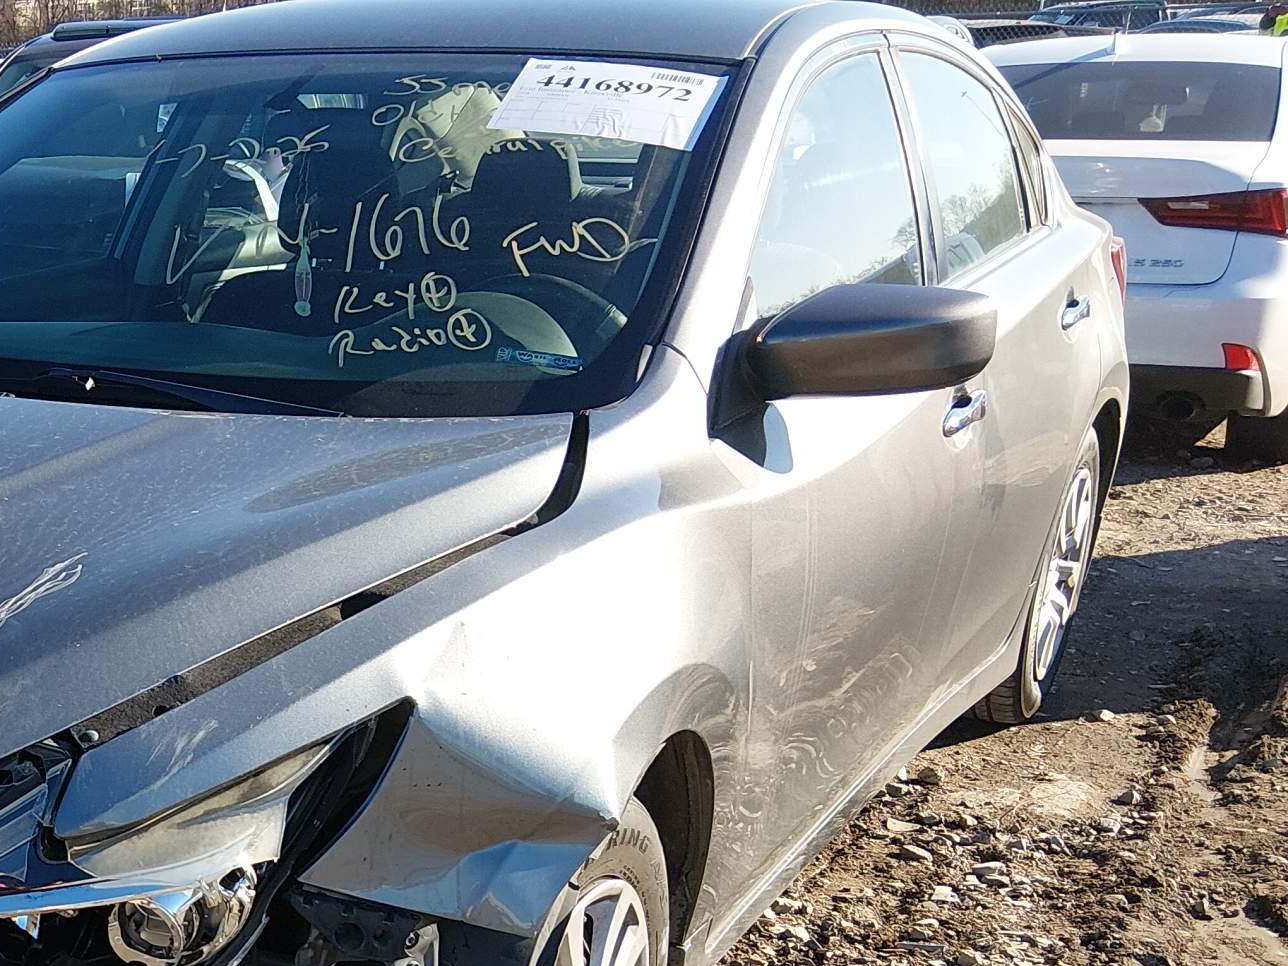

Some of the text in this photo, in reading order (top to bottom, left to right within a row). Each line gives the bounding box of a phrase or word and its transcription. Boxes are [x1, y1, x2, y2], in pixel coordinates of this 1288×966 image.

[536, 73, 693, 102] 44168972
[502, 216, 632, 278] FWD
[328, 326, 448, 368] Radio
[605, 827, 651, 856] RING
